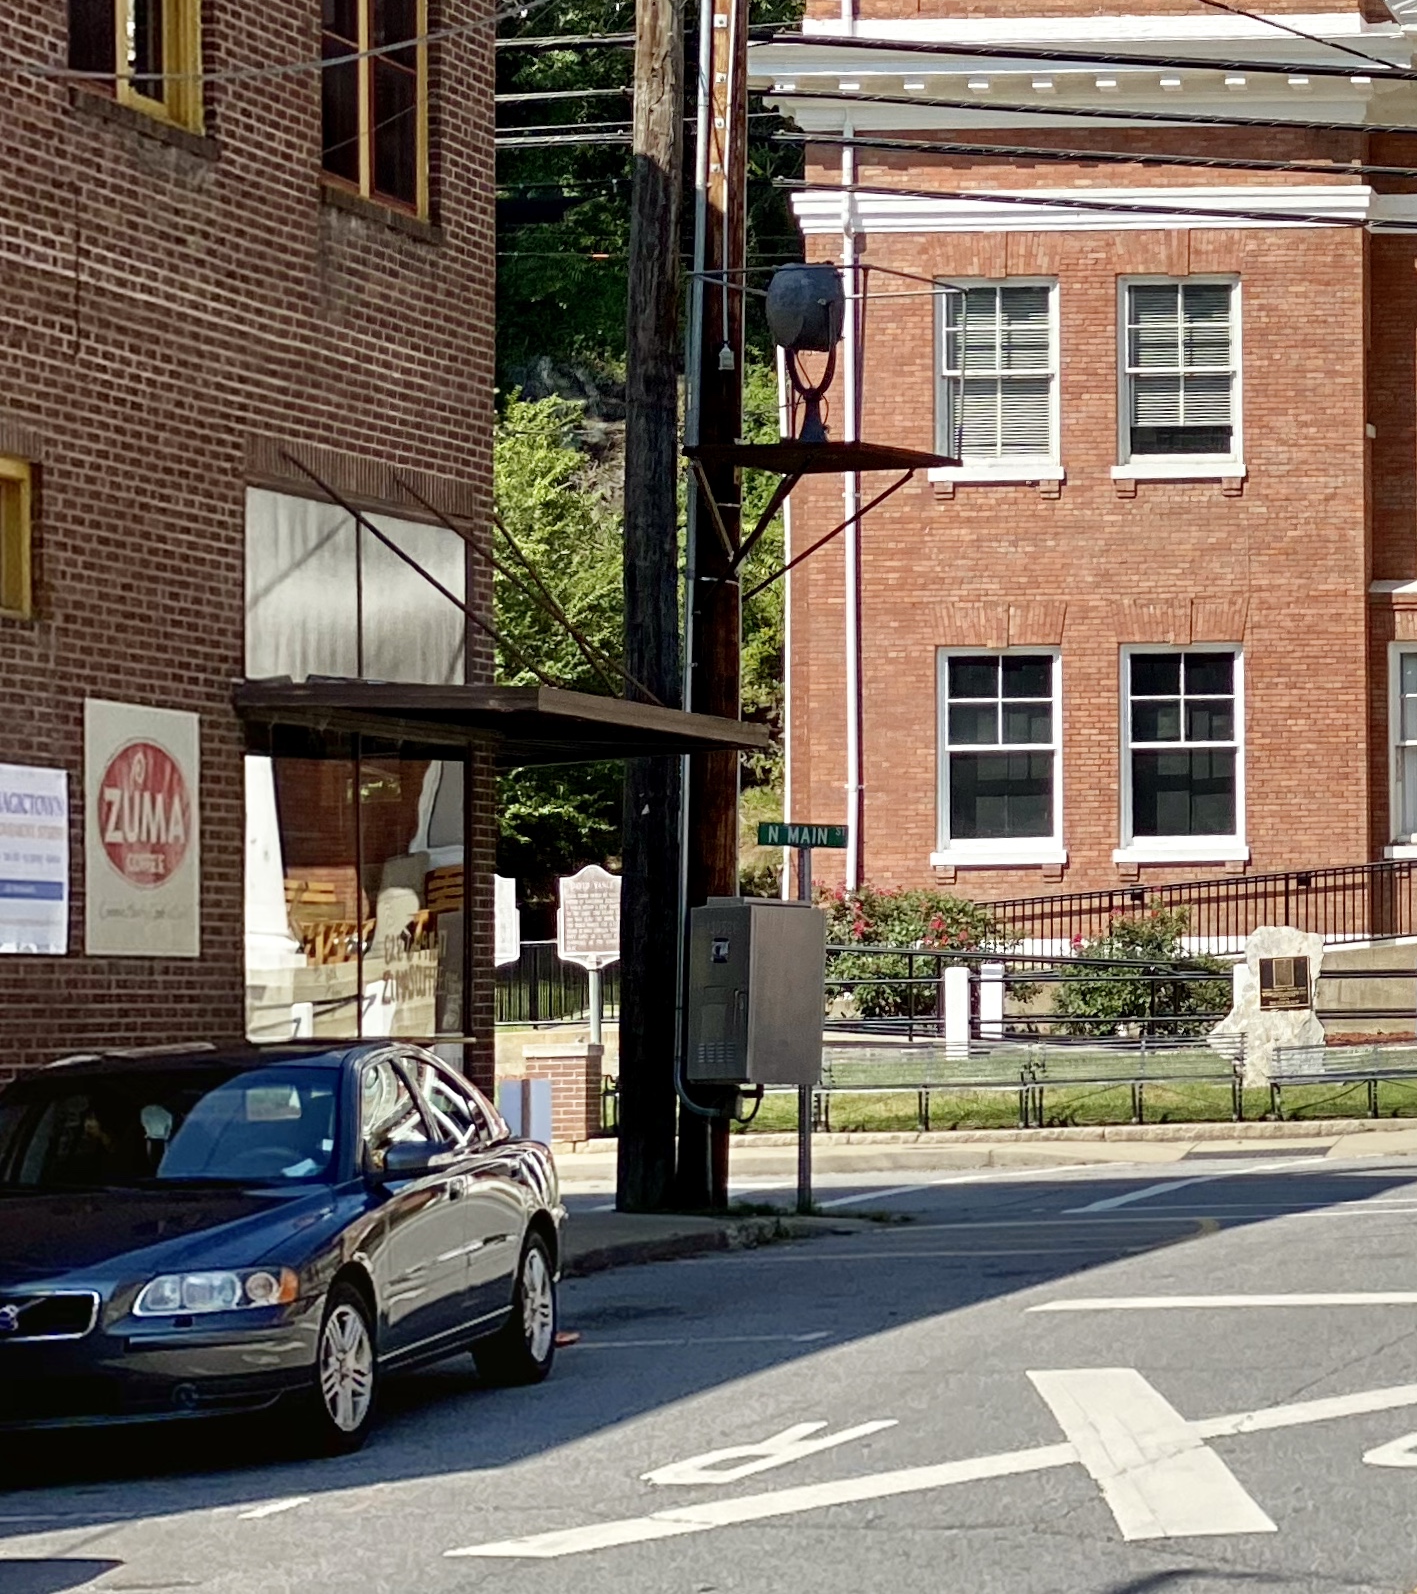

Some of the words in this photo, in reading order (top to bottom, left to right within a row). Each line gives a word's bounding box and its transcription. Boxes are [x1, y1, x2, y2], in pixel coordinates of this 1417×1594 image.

[103, 786, 186, 845] ZUMA
[768, 825, 779, 843] N
[787, 825, 828, 845] MAIN
[835, 827, 845, 837] ST
